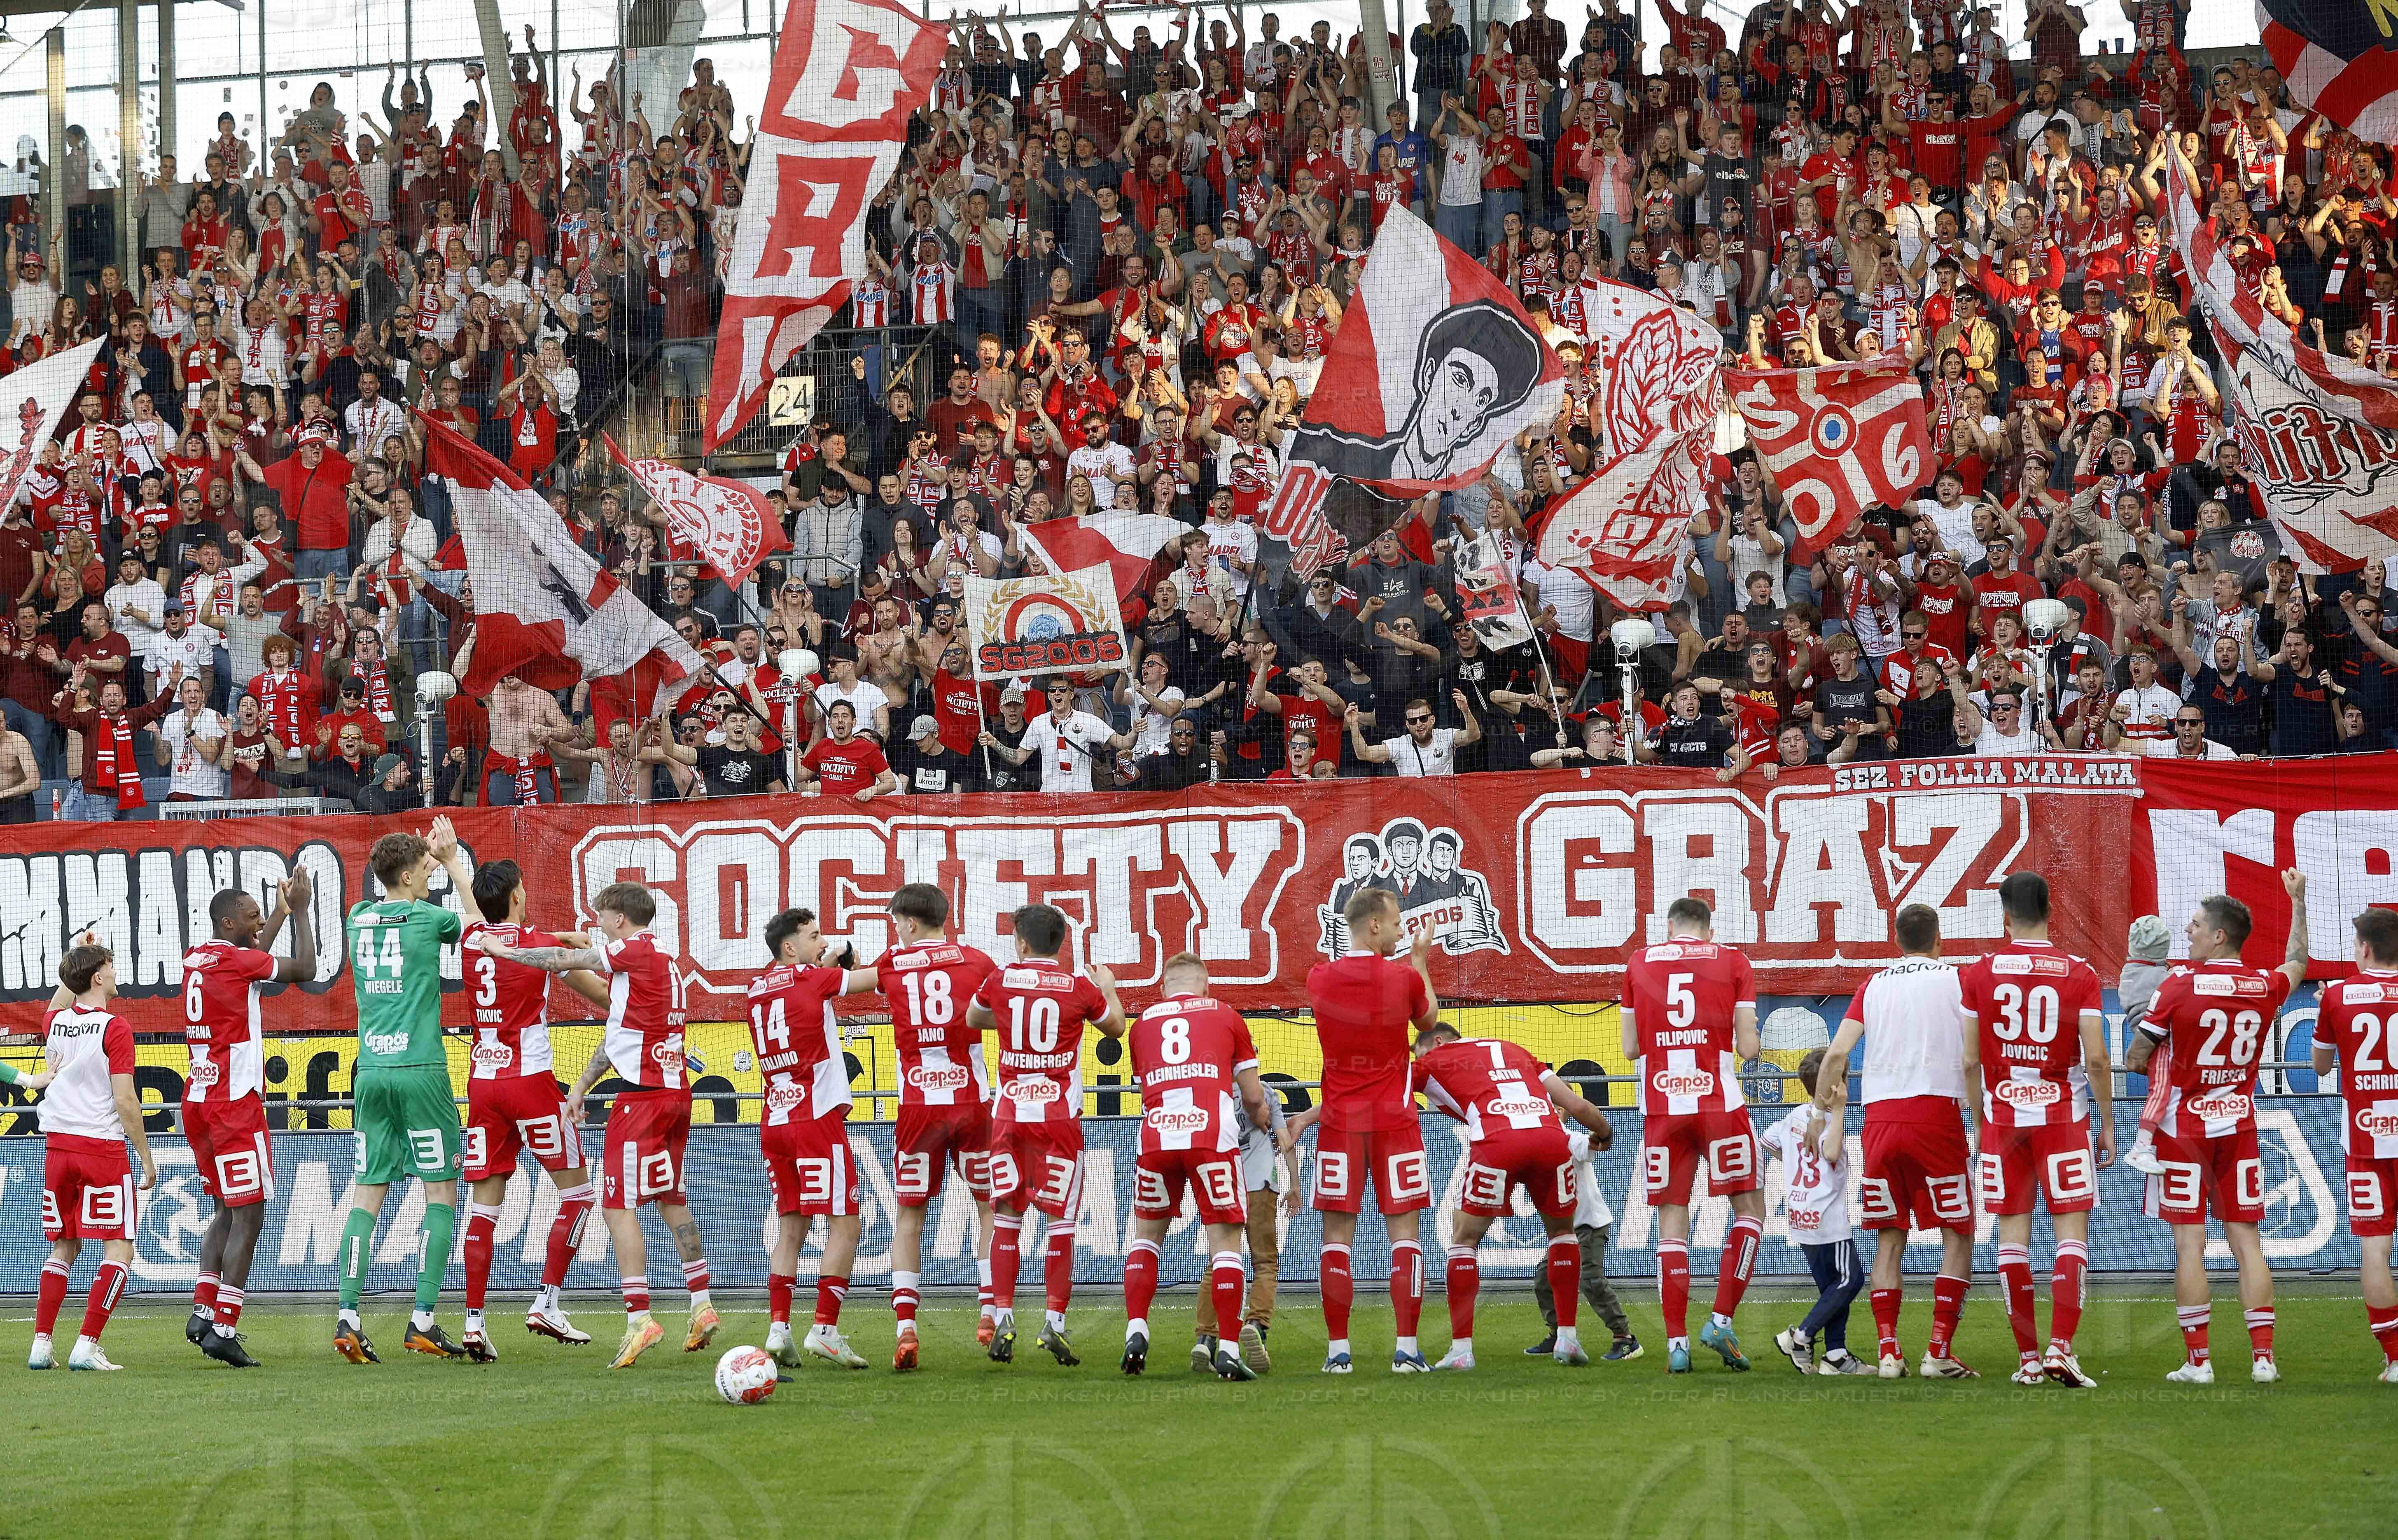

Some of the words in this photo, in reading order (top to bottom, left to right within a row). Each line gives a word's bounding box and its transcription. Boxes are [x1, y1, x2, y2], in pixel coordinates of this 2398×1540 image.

[1716, 169, 1749, 180] ellesse
[772, 383, 811, 419] 24
[978, 632, 1123, 673] SG2006
[1829, 692, 1866, 705] LONSDALE
[820, 762, 857, 775] SOCIETY
[1834, 766, 1895, 792] SEZ.
[1901, 762, 2006, 788] FOLLIA
[2013, 761, 2137, 786] MALATA
[918, 778, 943, 787] ukraine
[1524, 793, 2018, 966] GRAZ
[577, 812, 1295, 984] SOCIETY
[357, 928, 404, 978] 44
[364, 981, 403, 994] WIEGELE
[475, 957, 495, 1006] 3
[668, 959, 686, 1009] 11
[186, 971, 204, 1022] 6
[901, 971, 953, 1026] 18
[1666, 973, 1695, 1028] 5
[476, 1008, 503, 1023] TIKVIC
[1992, 984, 2058, 1043] 30
[751, 997, 790, 1055] 14
[1008, 996, 1060, 1053] 10
[918, 1027, 945, 1043] JANO
[1160, 1017, 1191, 1065] 8
[1656, 1029, 1708, 1047] FILIPOVIC
[2197, 1008, 2263, 1065] 28
[1475, 1041, 1506, 1069] 7
[2001, 1043, 2050, 1061] JOVICIC
[910, 1067, 966, 1087] Grapos
[1489, 1069, 1522, 1082] SATIN
[1655, 1073, 1711, 1090] Grapos
[1006, 1082, 1058, 1097] Grapos
[1999, 1083, 2057, 1101] Grapos
[2190, 1097, 2246, 1114] Grapos
[1149, 1111, 1205, 1127] Grapos
[605, 1176, 616, 1185] 11
[1788, 1190, 1808, 1202] FELIX
